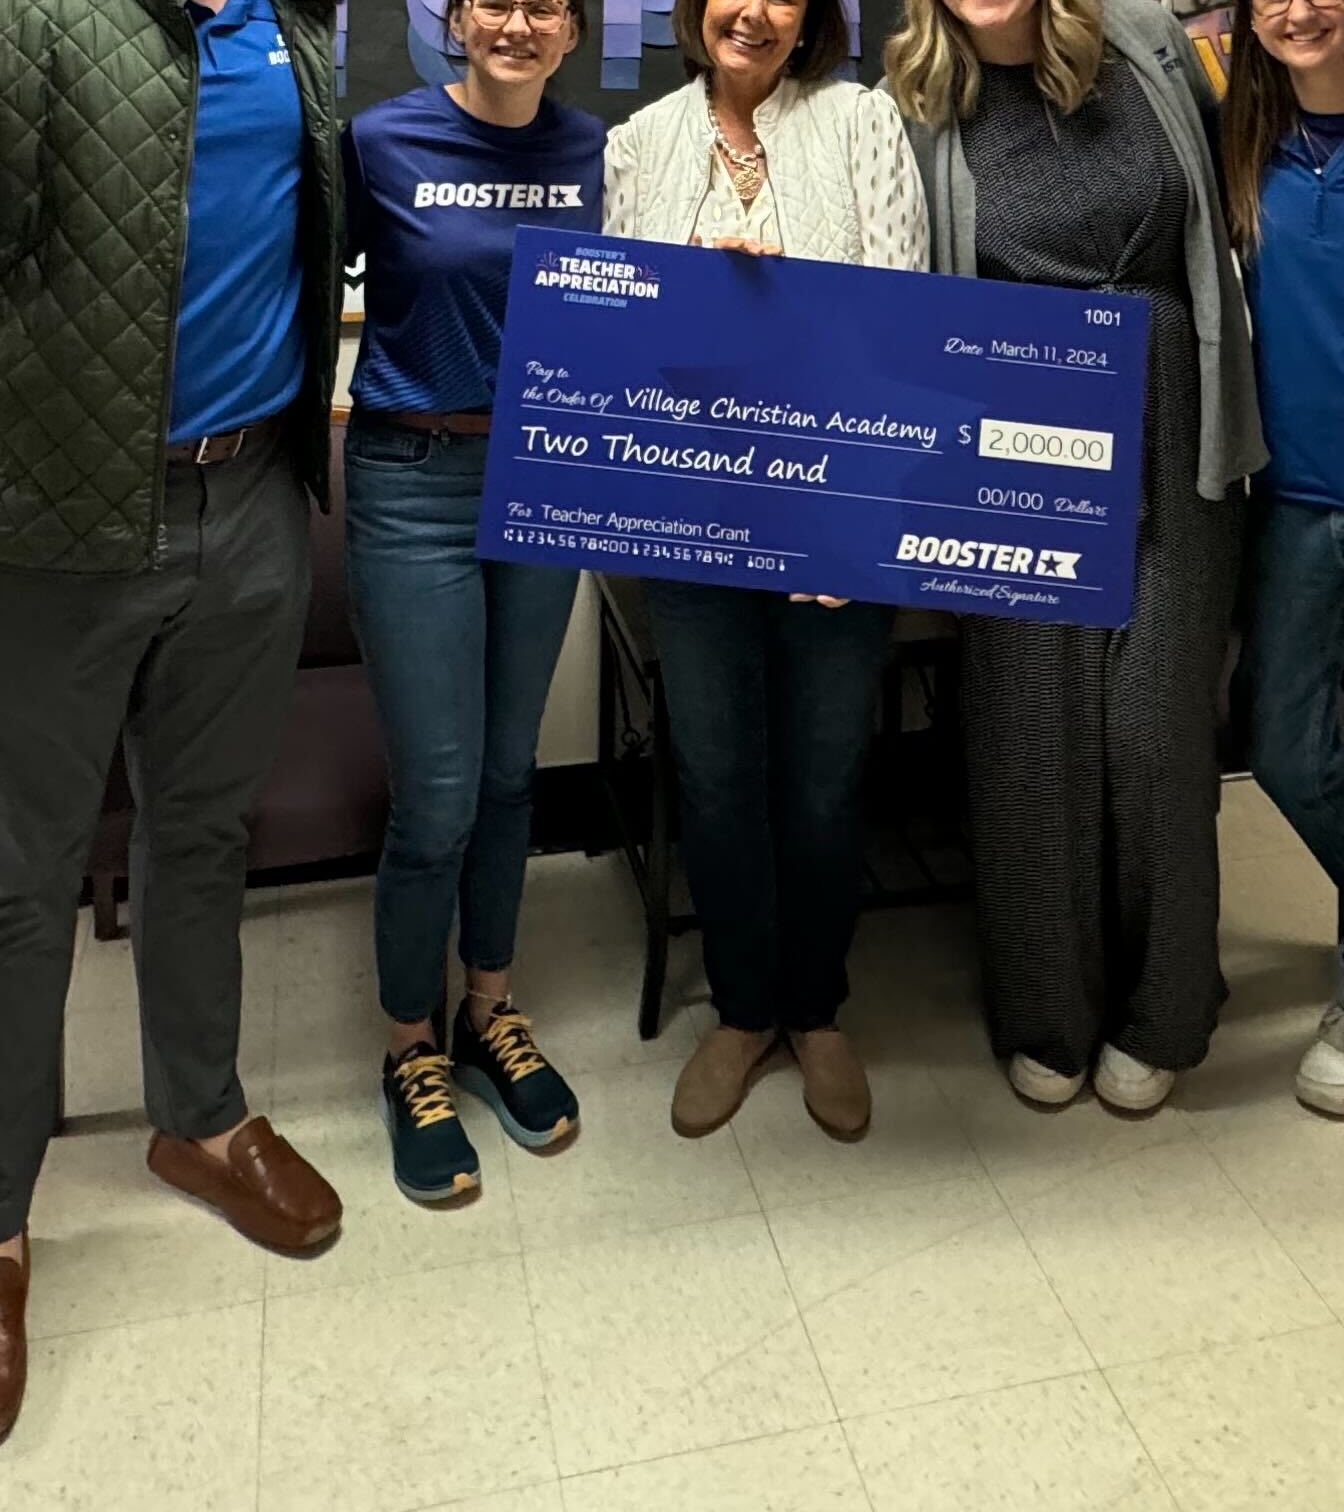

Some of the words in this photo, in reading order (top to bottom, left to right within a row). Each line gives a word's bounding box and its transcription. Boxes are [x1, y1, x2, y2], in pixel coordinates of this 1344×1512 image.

[414, 182, 544, 208] BOOSTER
[559, 256, 636, 280] TEACHER
[534, 270, 659, 299] APPRECIATION
[563, 292, 628, 308] CELEBRATION
[1084, 308, 1120, 327] 1001
[944, 337, 984, 356] Date
[991, 339, 1038, 359] March
[1043, 345, 1062, 364] 11,
[1066, 348, 1108, 367] 2024
[526, 360, 555, 383] Pay
[557, 367, 570, 378] to
[522, 385, 544, 402] the
[546, 387, 587, 406] Order
[589, 392, 613, 414] Of
[625, 386, 702, 421] Village
[710, 396, 819, 429] Christian
[825, 411, 937, 449] Academy
[958, 424, 972, 445] $
[989, 429, 1104, 462] 2,000.00
[521, 425, 589, 457] Two
[602, 433, 755, 476] Thousand
[766, 453, 828, 484] and
[977, 486, 1044, 511] 00/100
[1053, 496, 1109, 518] Dollars
[507, 501, 533, 518] For
[541, 504, 603, 526] Teacher
[606, 511, 702, 537] Appreciation
[706, 522, 751, 543] Grant
[896, 533, 1034, 575] BOOSTER
[920, 576, 998, 600] Authorized
[996, 585, 1060, 607] Signature
